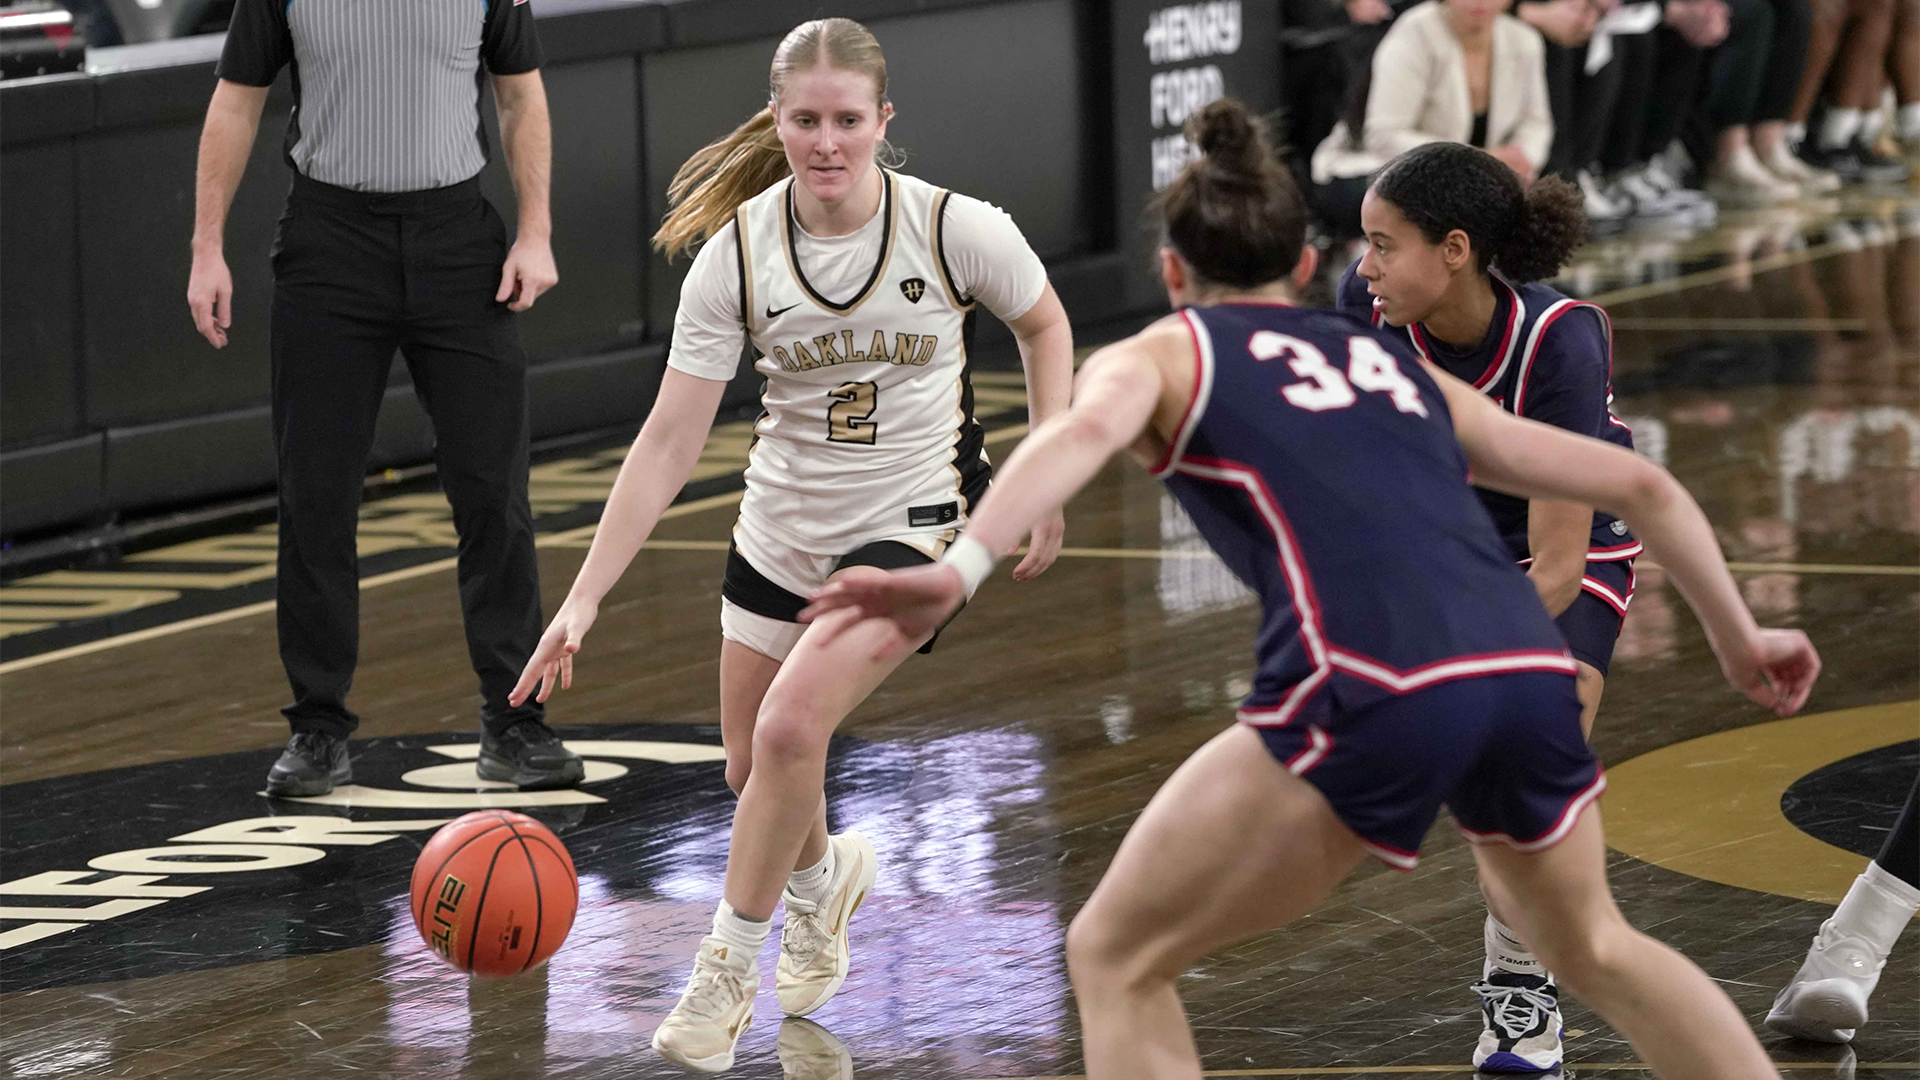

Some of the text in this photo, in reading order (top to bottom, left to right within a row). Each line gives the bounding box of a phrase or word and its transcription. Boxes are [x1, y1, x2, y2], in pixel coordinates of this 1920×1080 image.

[1143, 0, 1243, 65] HENRY
[1150, 64, 1226, 129] FORD
[773, 329, 938, 373] OAKLAND
[1247, 329, 1430, 419] 34
[826, 381, 879, 445] 2
[944, 509, 952, 518] S
[431, 874, 467, 958] ELITE
